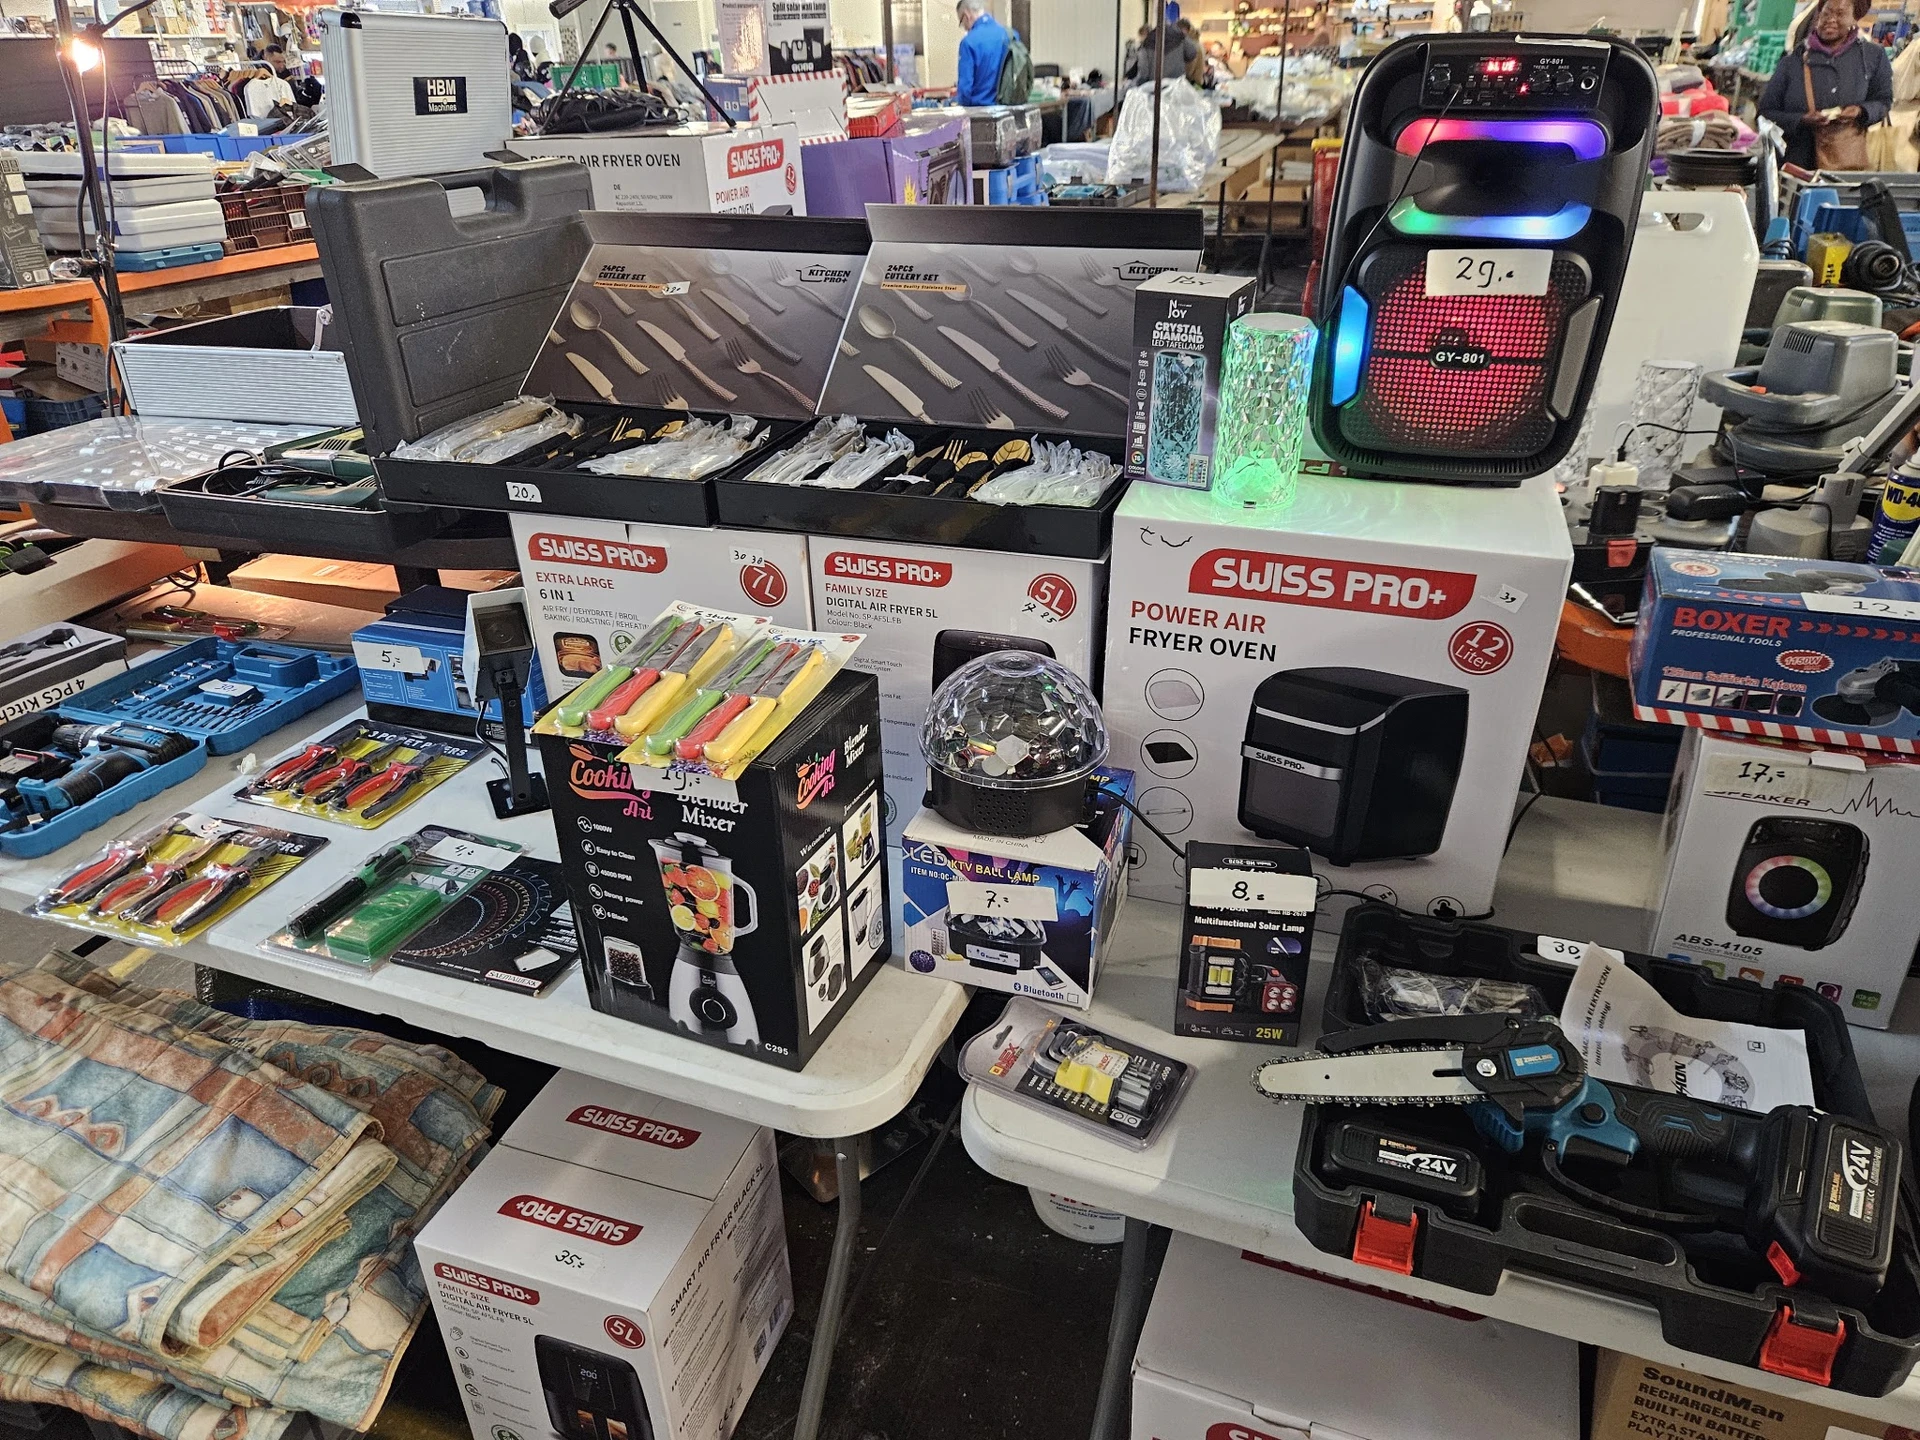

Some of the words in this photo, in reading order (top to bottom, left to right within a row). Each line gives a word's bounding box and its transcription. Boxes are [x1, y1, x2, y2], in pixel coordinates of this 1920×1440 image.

[427, 79, 456, 96] HBM
[428, 103, 457, 112] Machines
[603, 154, 643, 168] FRYER
[645, 153, 681, 167] OVEN
[731, 147, 761, 173] SWISS
[715, 188, 738, 204] POWER
[598, 272, 629, 280] CUTLERY
[808, 269, 851, 277] KITCHEN
[884, 273, 920, 281] CUTLERY
[1152, 330, 1204, 344] DIAMOND
[1155, 321, 1203, 335] CRYSTAL
[1152, 339, 1165, 347] LED
[1165, 340, 1204, 351] TAFELLAMP
[1436, 351, 1485, 364] GY-801
[538, 537, 603, 562] SWISS
[604, 545, 656, 568] PRO+
[834, 556, 892, 578] SWISS
[895, 562, 941, 583] PRO+
[536, 571, 575, 585] EXTRA
[576, 576, 615, 590] LARGE
[752, 567, 777, 600] 7L
[1211, 557, 1335, 599] SWISS
[1343, 570, 1447, 610] PRO+
[540, 588, 548, 600] 6
[550, 589, 564, 601] IN
[567, 591, 575, 602] 1
[825, 583, 863, 595] FAMILY
[865, 587, 888, 599] SIZE
[1034, 581, 1065, 614] 5L
[573, 607, 613, 618] DEHYDRATE
[619, 612, 640, 621] BROIL
[826, 596, 867, 610] DIGITAL
[869, 601, 887, 613] AIR
[889, 604, 923, 617] FRYER
[925, 608, 939, 619] 5L
[827, 609, 848, 618] Model
[849, 611, 861, 620] No.
[1131, 600, 1219, 629] POWER
[1223, 612, 1266, 634] AIR
[544, 613, 571, 623] BAKING
[576, 616, 611, 627] ROASTING
[853, 620, 873, 630] Black
[1673, 606, 1792, 638] BOXER
[1129, 627, 1203, 654] FRYER
[1209, 637, 1277, 662] OVEN
[1670, 629, 1746, 643] PROFESSIONAL
[1749, 637, 1783, 647] TOOLS
[870, 659, 886, 667] Smart
[886, 660, 902, 668] Touch
[1455, 644, 1492, 669] Liter
[42, 682, 74, 705] PCS
[75, 679, 85, 691] 4
[884, 717, 915, 727] Temperature
[368, 730, 376, 738] 3
[844, 723, 869, 756] Blender
[884, 748, 909, 757] Shutdown
[1255, 751, 1283, 765] SWISS
[1283, 759, 1305, 770] PRO+
[797, 748, 836, 803] Cooking
[622, 800, 655, 821] Art
[681, 805, 736, 833] Mixer
[592, 823, 613, 834] 1000W
[973, 835, 994, 843] MADE
[1005, 840, 1029, 849] CHINA
[596, 846, 611, 856] Easy
[618, 851, 636, 861] Clean
[909, 846, 948, 867] LED
[951, 860, 973, 873] KTV
[975, 865, 1004, 879] BALL
[1007, 869, 1041, 884] LAMP
[910, 866, 928, 877] ITEM
[617, 873, 633, 882] RPM
[603, 890, 624, 902] Strong
[625, 897, 644, 906] power
[611, 912, 629, 922] Blade
[1194, 915, 1257, 929] Multifunctional
[1258, 921, 1281, 932] Solar
[1282, 923, 1305, 934] Lamp
[1674, 933, 1764, 956] ABS-4105
[1023, 984, 1064, 1000] Bluetooth
[1587, 965, 1612, 1017] ELEKTRYCZNE
[1255, 1027, 1283, 1040] 25W
[764, 1042, 789, 1056] C295
[579, 1108, 639, 1133] SWISS
[637, 1122, 685, 1144] PRO+
[1418, 1156, 1457, 1175] 24V
[1848, 1140, 1872, 1181] 24V
[516, 1200, 567, 1225] PRO+
[563, 1213, 630, 1242] SWISS
[670, 1269, 697, 1317] SMART
[697, 1248, 711, 1273] AIR
[710, 1211, 733, 1251] FRYER
[733, 1175, 756, 1213] BLACK
[756, 1162, 765, 1178] 5L
[437, 1281, 468, 1296] FAMILY
[470, 1291, 491, 1304] SIZE
[441, 1265, 491, 1290] SWISS
[491, 1280, 532, 1301] PRO+
[439, 1290, 474, 1308] DIGITAL
[476, 1302, 492, 1313] AIR
[493, 1307, 521, 1322] FRYER
[522, 1316, 535, 1326] 5L
[611, 1319, 637, 1345] 5L
[1642, 1365, 1785, 1423] SoundMan
[1633, 1395, 1702, 1426] BUILT-IN
[1638, 1381, 1764, 1431] RECHARGEABLE
[1630, 1410, 1677, 1432] EXTRA
